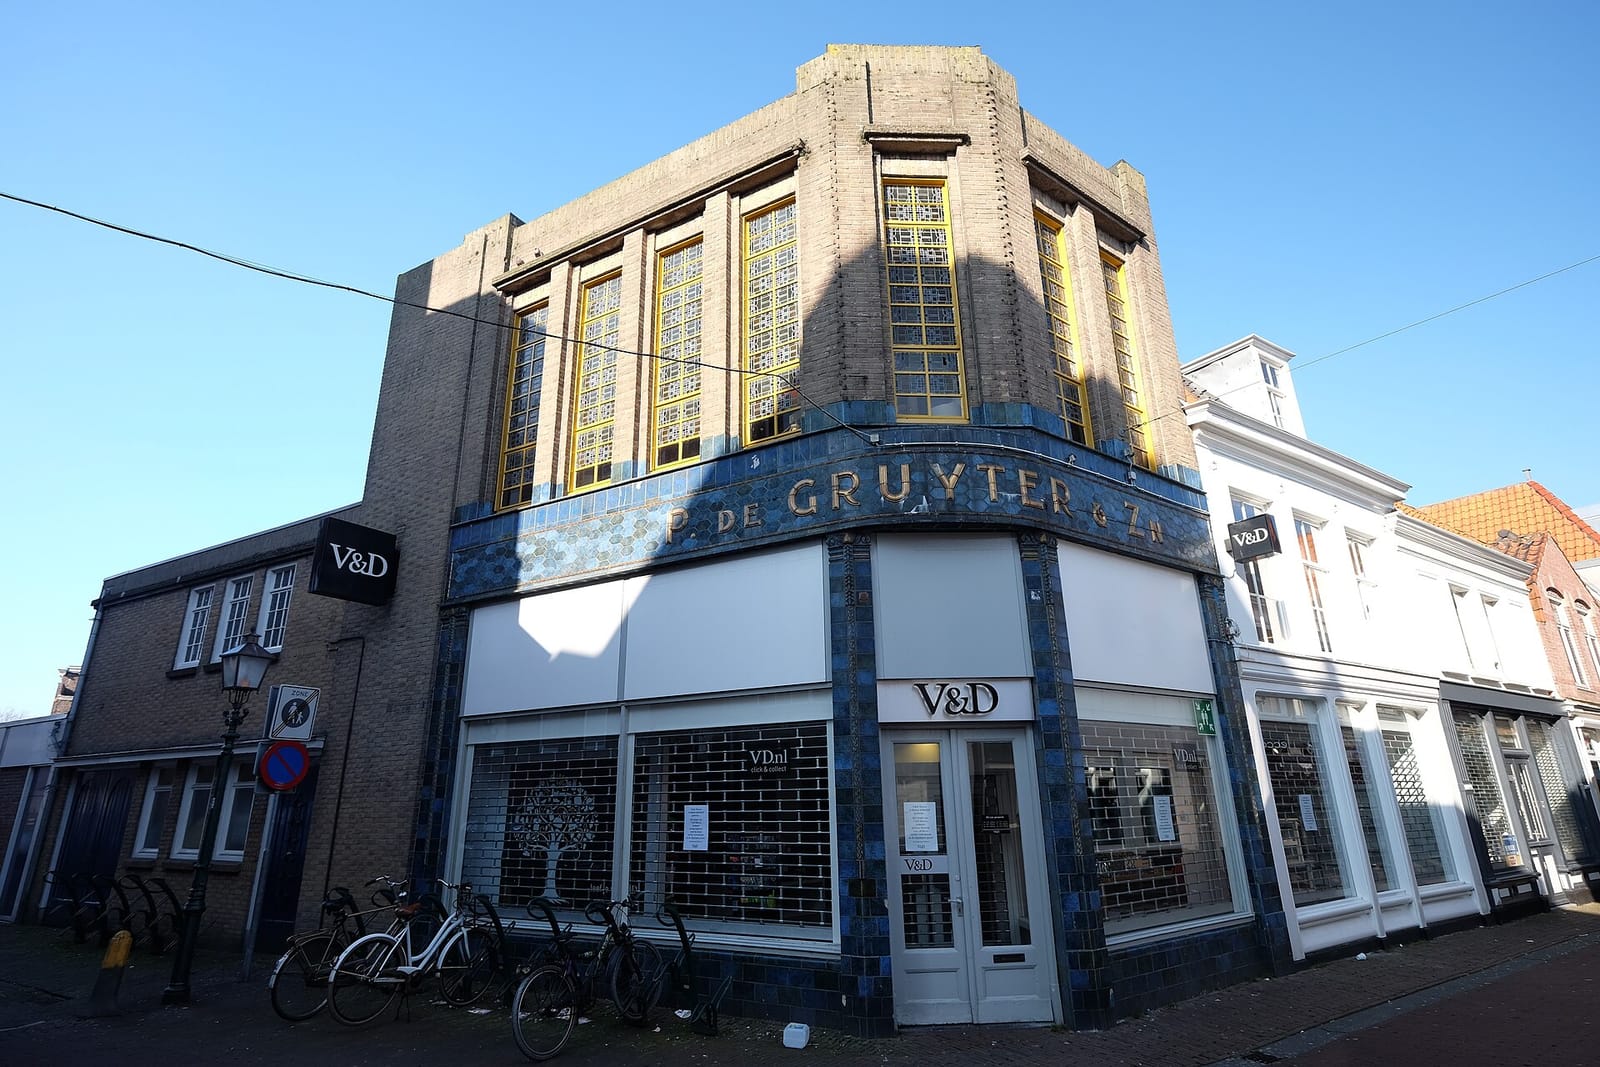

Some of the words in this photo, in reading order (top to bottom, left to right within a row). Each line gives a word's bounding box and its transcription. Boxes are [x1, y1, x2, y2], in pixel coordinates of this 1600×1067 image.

[666, 507, 696, 544] P.
[718, 502, 762, 534] DE
[787, 463, 1073, 519] GRUYTER
[1124, 500, 1163, 544] ZN
[1232, 527, 1268, 547] V&D
[329, 542, 388, 577] V&D
[914, 682, 999, 716] V&D
[749, 749, 788, 764] VD.nl
[903, 858, 933, 871] V&D
